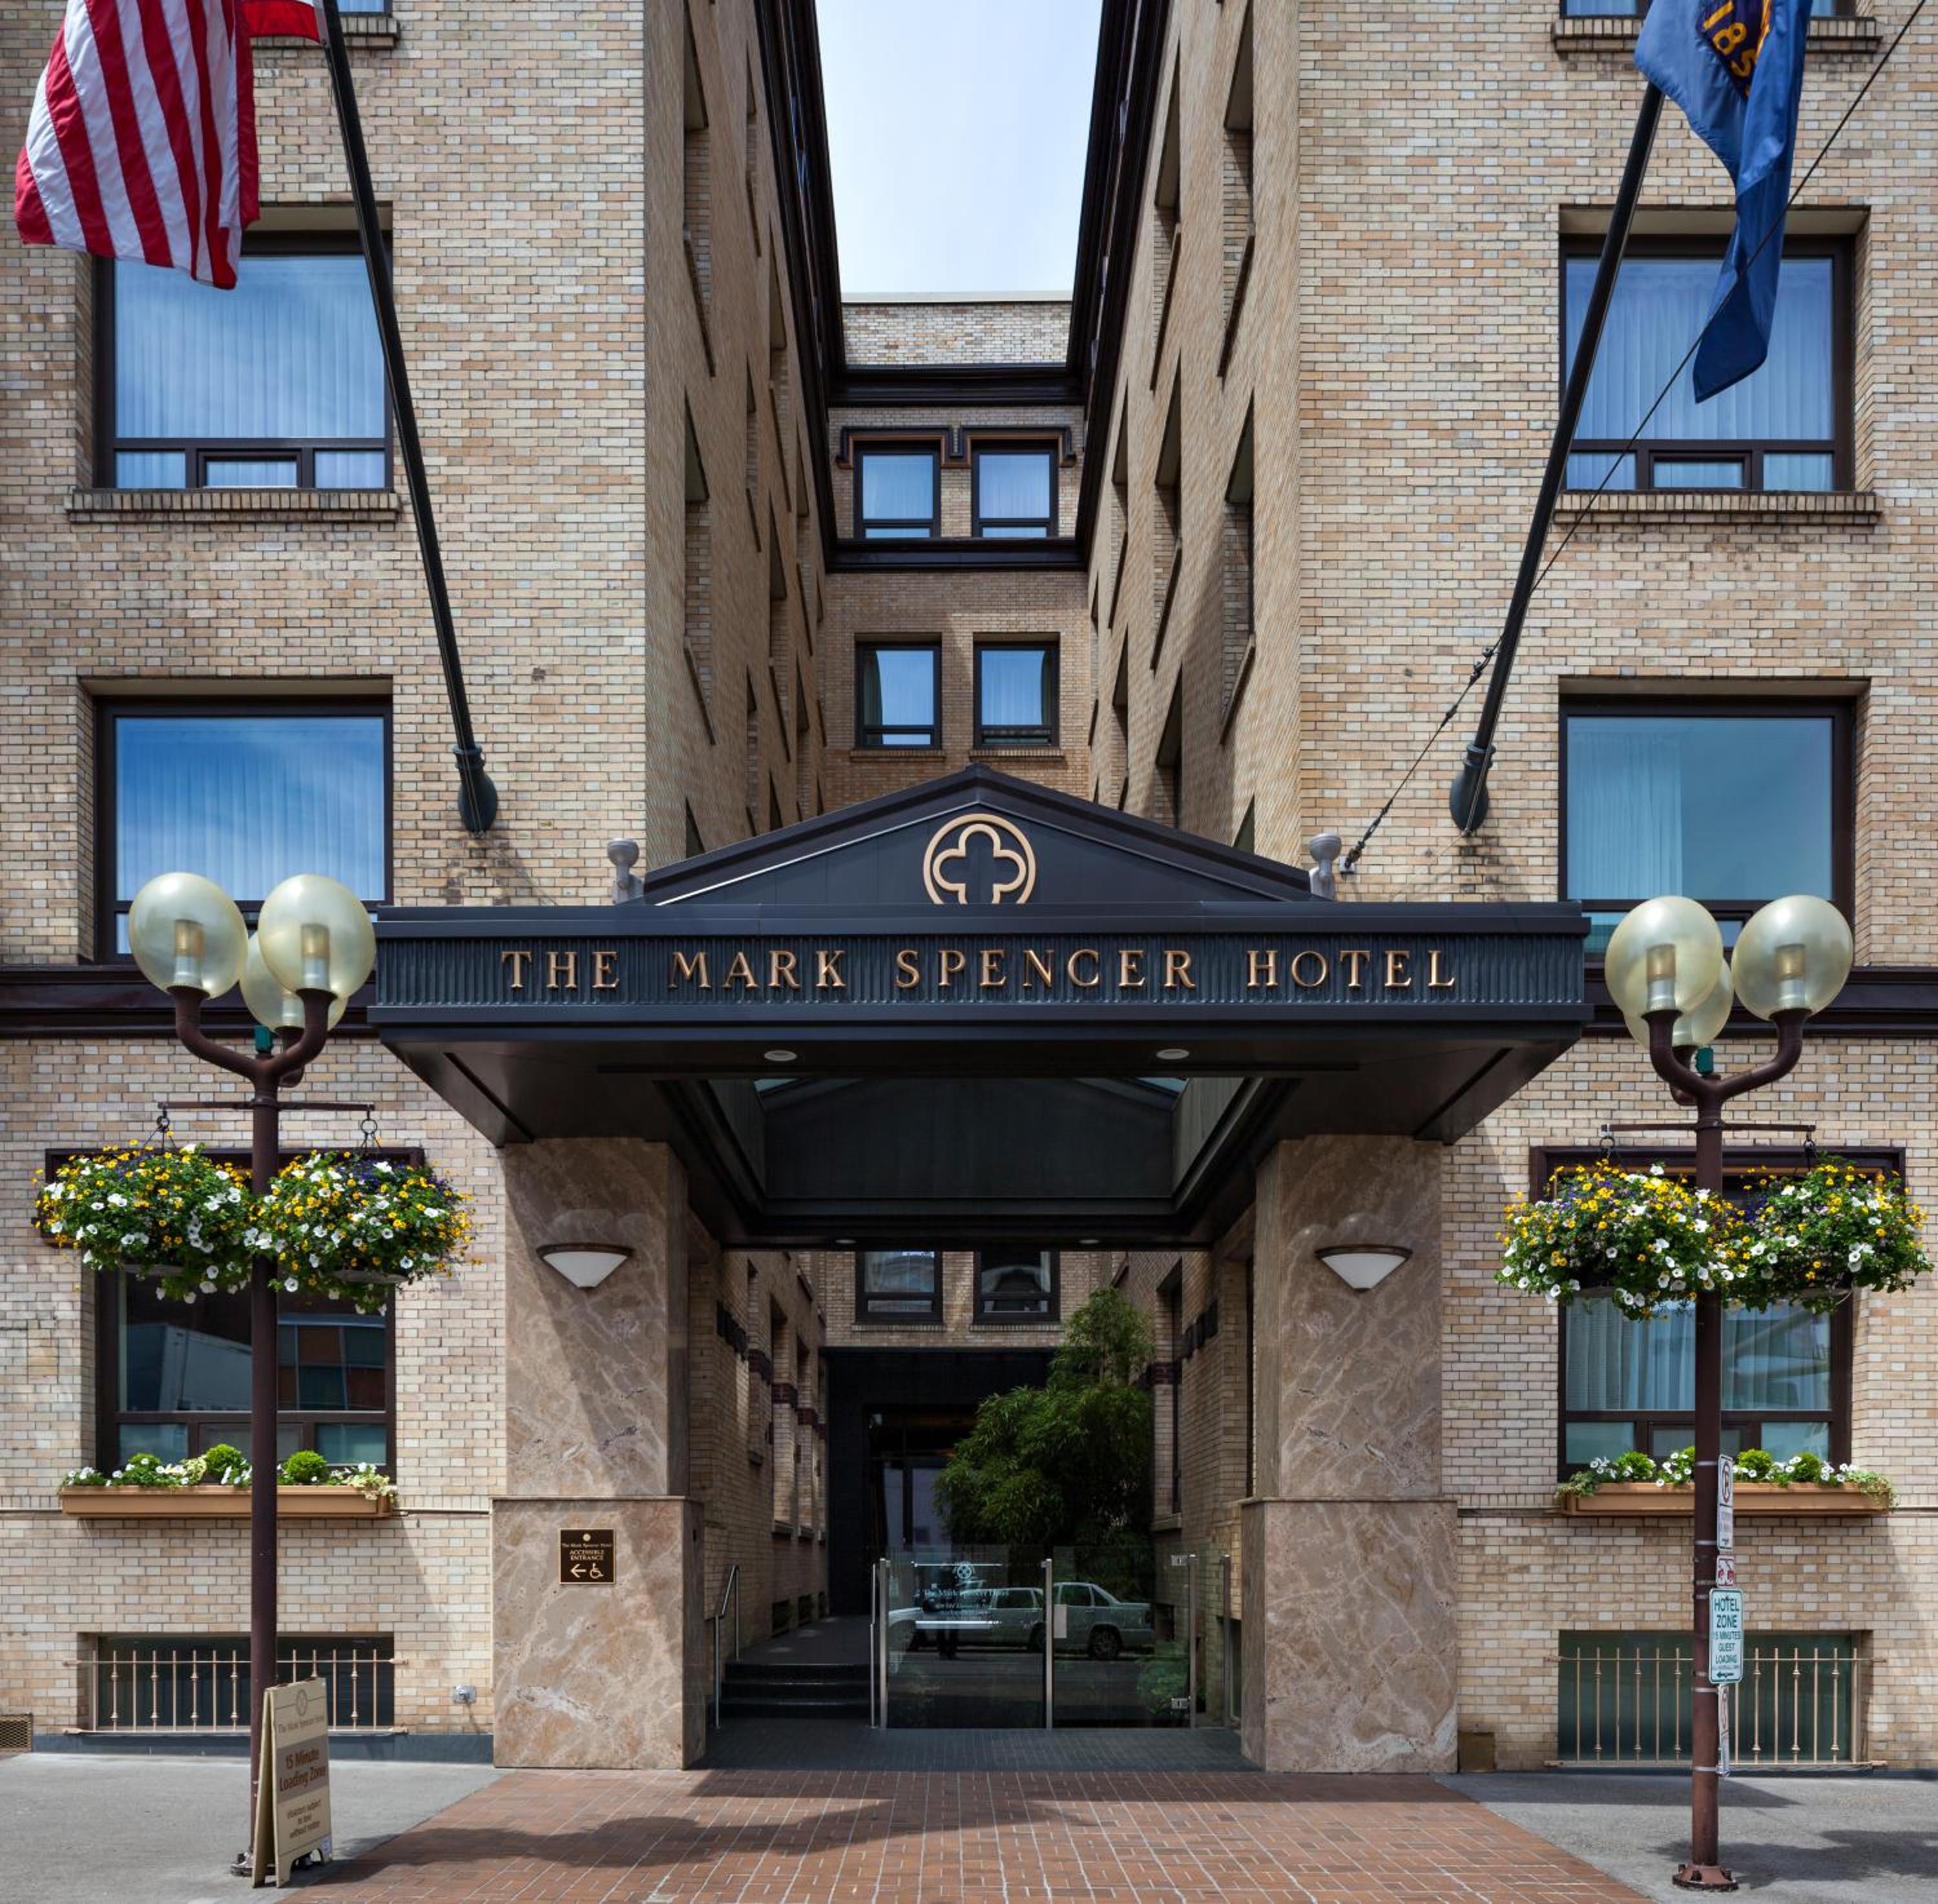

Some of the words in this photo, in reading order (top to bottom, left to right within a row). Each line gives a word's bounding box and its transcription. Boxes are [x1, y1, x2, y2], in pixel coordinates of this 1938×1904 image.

[1702, 0, 1758, 96] 185
[501, 950, 621, 989] THE
[667, 950, 846, 989] MARK
[895, 949, 1196, 989] SPENCER
[1247, 949, 1456, 988] HOTEL
[1714, 1597, 1740, 1612] HOTEL
[1716, 1615, 1738, 1628] ZONE
[1720, 1631, 1741, 1640] MINUTES
[1718, 1642, 1736, 1652] GUEST
[1715, 1654, 1737, 1664] LOADING
[280, 1770, 311, 1792] Loading
